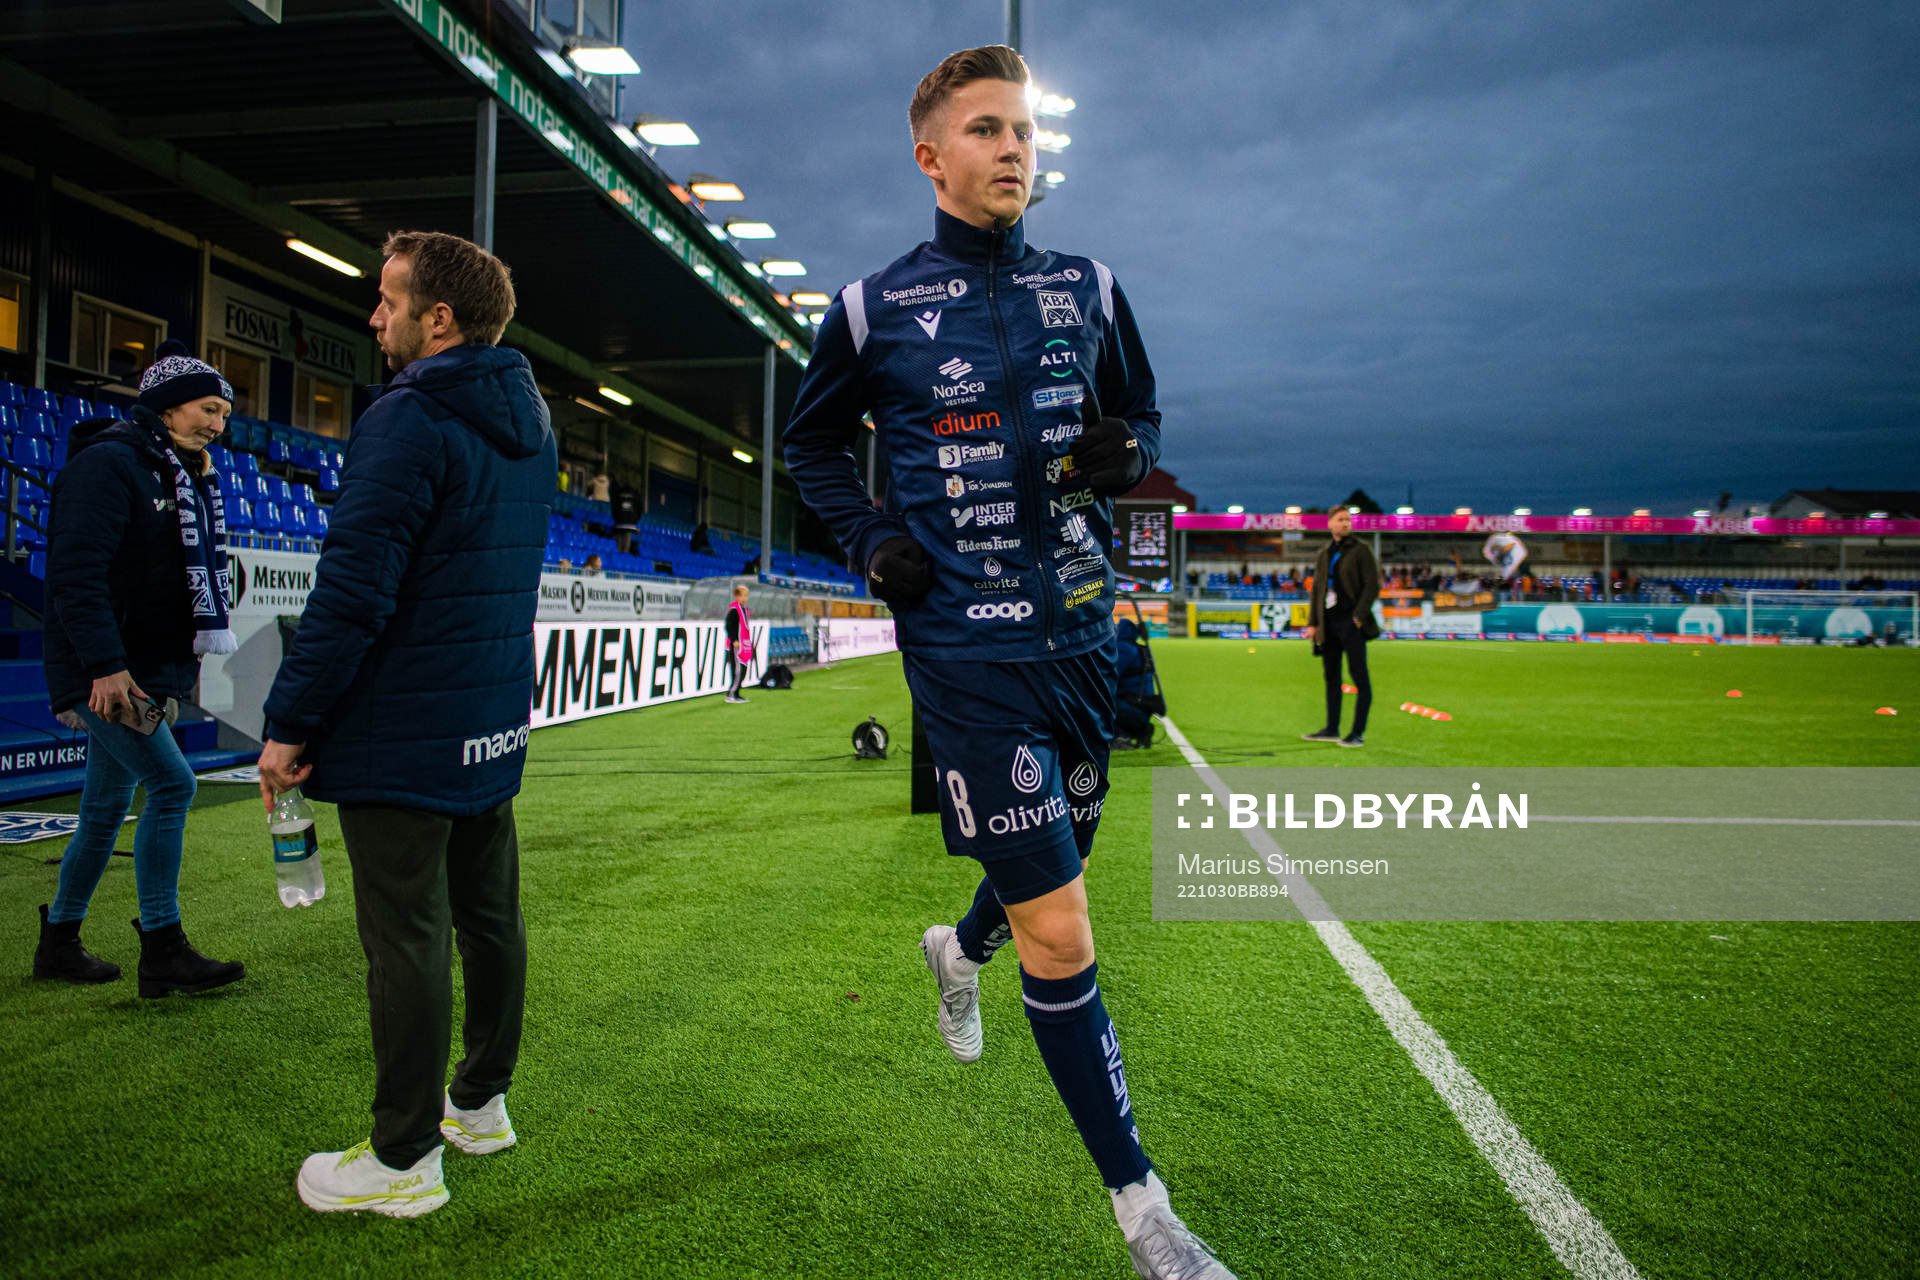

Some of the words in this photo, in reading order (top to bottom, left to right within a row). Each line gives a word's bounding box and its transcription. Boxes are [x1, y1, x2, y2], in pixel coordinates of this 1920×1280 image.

[438, 5, 503, 91] notar
[510, 74, 563, 149] notar
[1012, 272, 1064, 286] SpareBank
[883, 282, 946, 303] SpareBank
[899, 293, 948, 307] NORDMØRE
[226, 303, 280, 347] FOSNA
[310, 335, 356, 372] STEIN
[1039, 351, 1078, 367] ALTI
[932, 381, 986, 400] NorSea
[944, 396, 977, 407] VESTBASE
[931, 411, 1001, 437] idium
[961, 441, 1005, 460] Family
[975, 502, 1015, 516] INTER
[976, 513, 1016, 527] SPORT
[974, 578, 1019, 590] olivita
[966, 601, 1034, 622] coop
[650, 627, 687, 699] ER
[696, 626, 719, 691] VI
[16, 751, 36, 769] ER
[38, 749, 54, 766] VI
[57, 745, 87, 764] KBK
[988, 795, 1067, 835] olivita
[389, 1174, 424, 1193] HOKA
